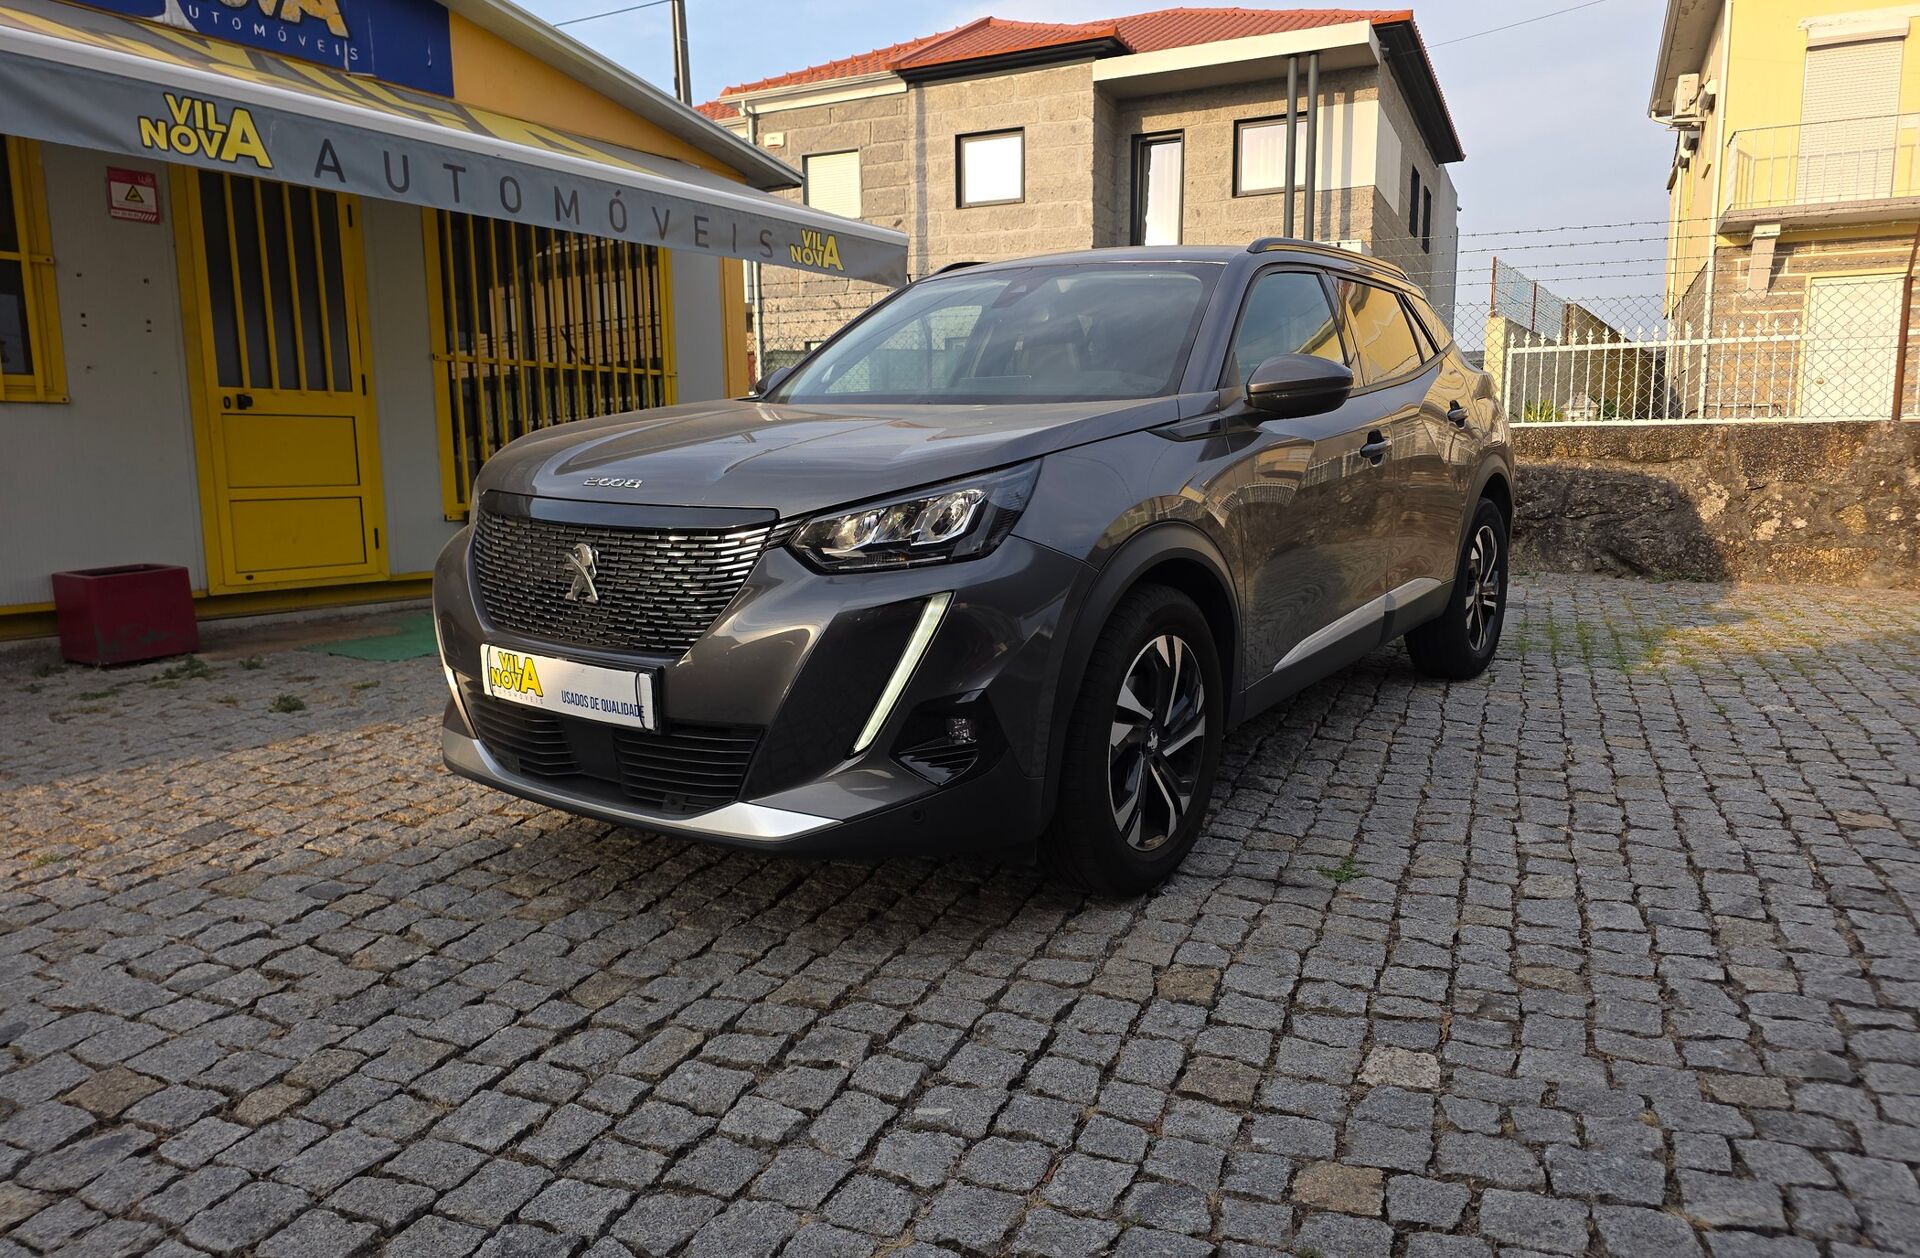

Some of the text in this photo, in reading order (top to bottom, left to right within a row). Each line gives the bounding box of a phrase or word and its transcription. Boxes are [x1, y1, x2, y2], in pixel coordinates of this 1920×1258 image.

[187, 4, 358, 61] UTOMÓVEIS
[138, 106, 273, 169] NOVA
[314, 138, 774, 259] AUTOMÓVEIS
[789, 233, 845, 272] NOVA
[583, 477, 643, 489] 2008
[561, 690, 645, 719] USADOS DE QUALIDADE
